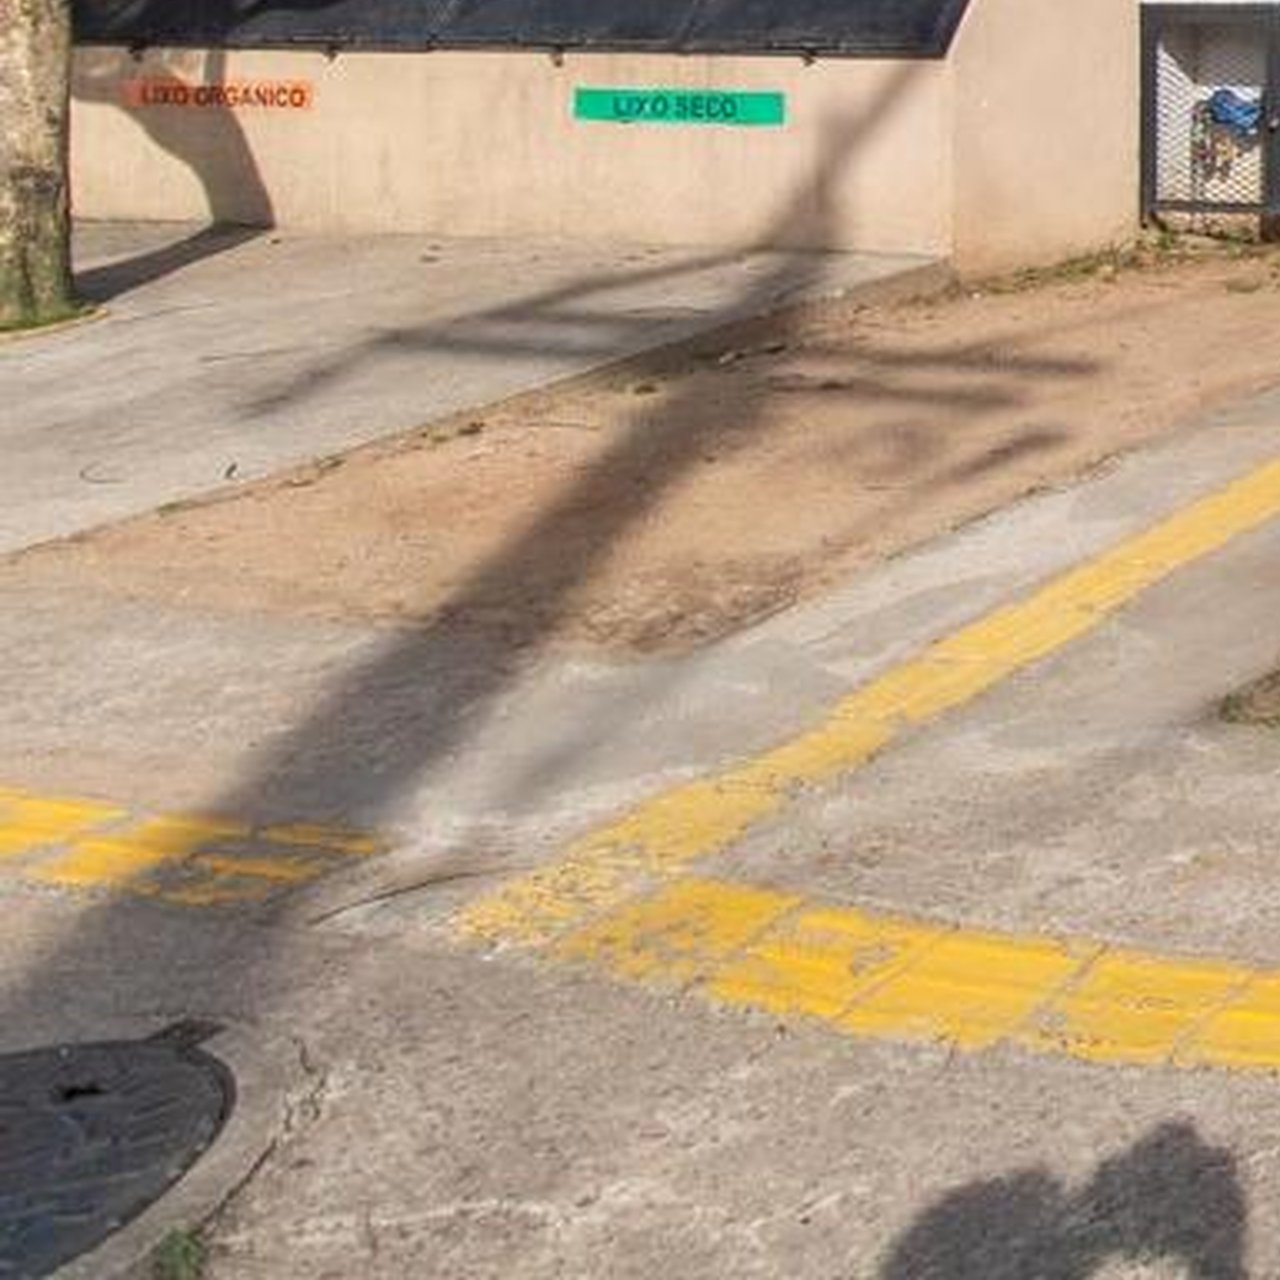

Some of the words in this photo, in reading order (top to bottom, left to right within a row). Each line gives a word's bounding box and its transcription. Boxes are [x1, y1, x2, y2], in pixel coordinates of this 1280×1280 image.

[141, 85, 189, 106] LIXO
[612, 95, 669, 117] LIXO
[675, 95, 738, 118] SECO
